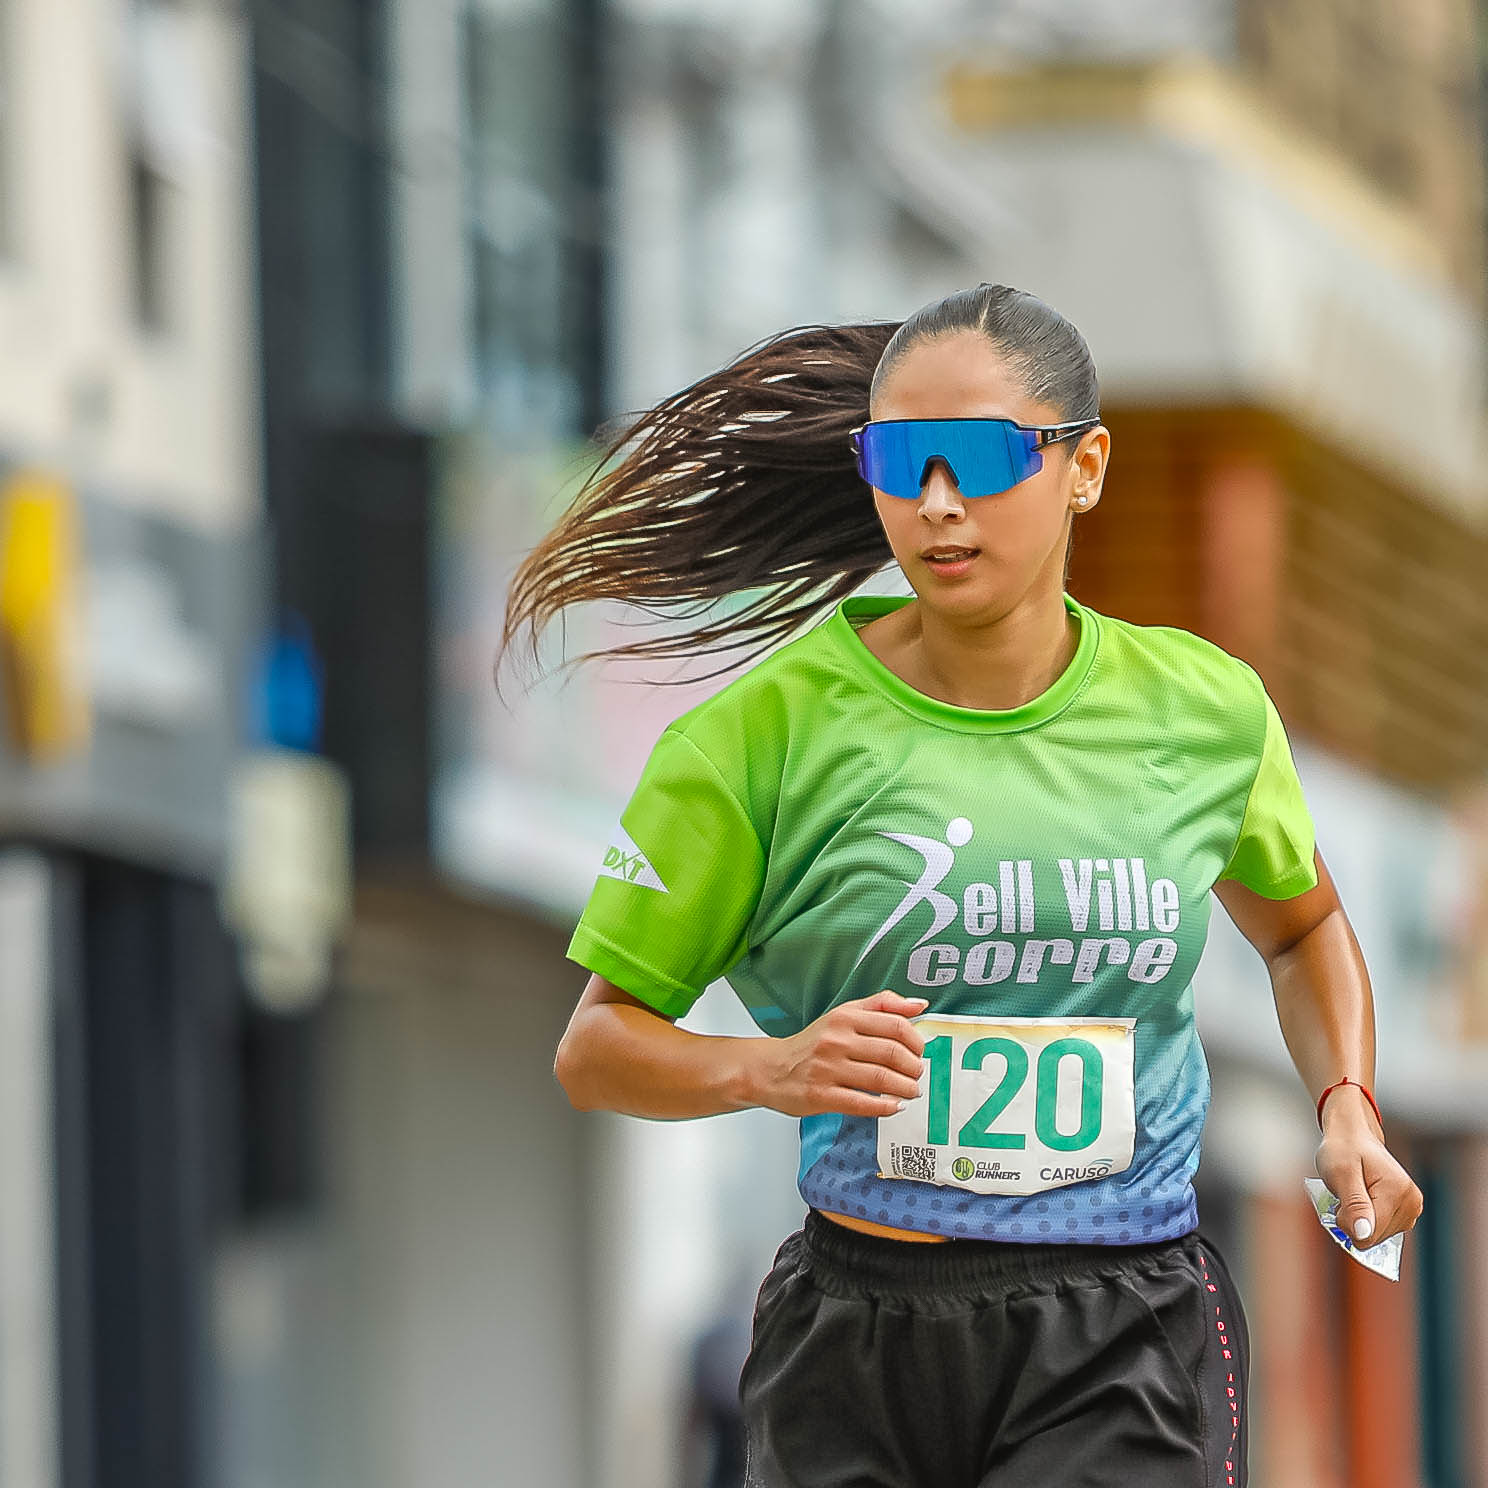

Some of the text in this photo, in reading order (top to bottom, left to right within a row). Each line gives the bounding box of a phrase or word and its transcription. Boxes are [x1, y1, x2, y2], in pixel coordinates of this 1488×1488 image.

[1057, 857, 1180, 934] Ville
[906, 937, 1179, 987] corre
[923, 1034, 1104, 1152] 120
[976, 1161, 1001, 1171] CLUB
[1039, 1166, 1109, 1183] CARUSO
